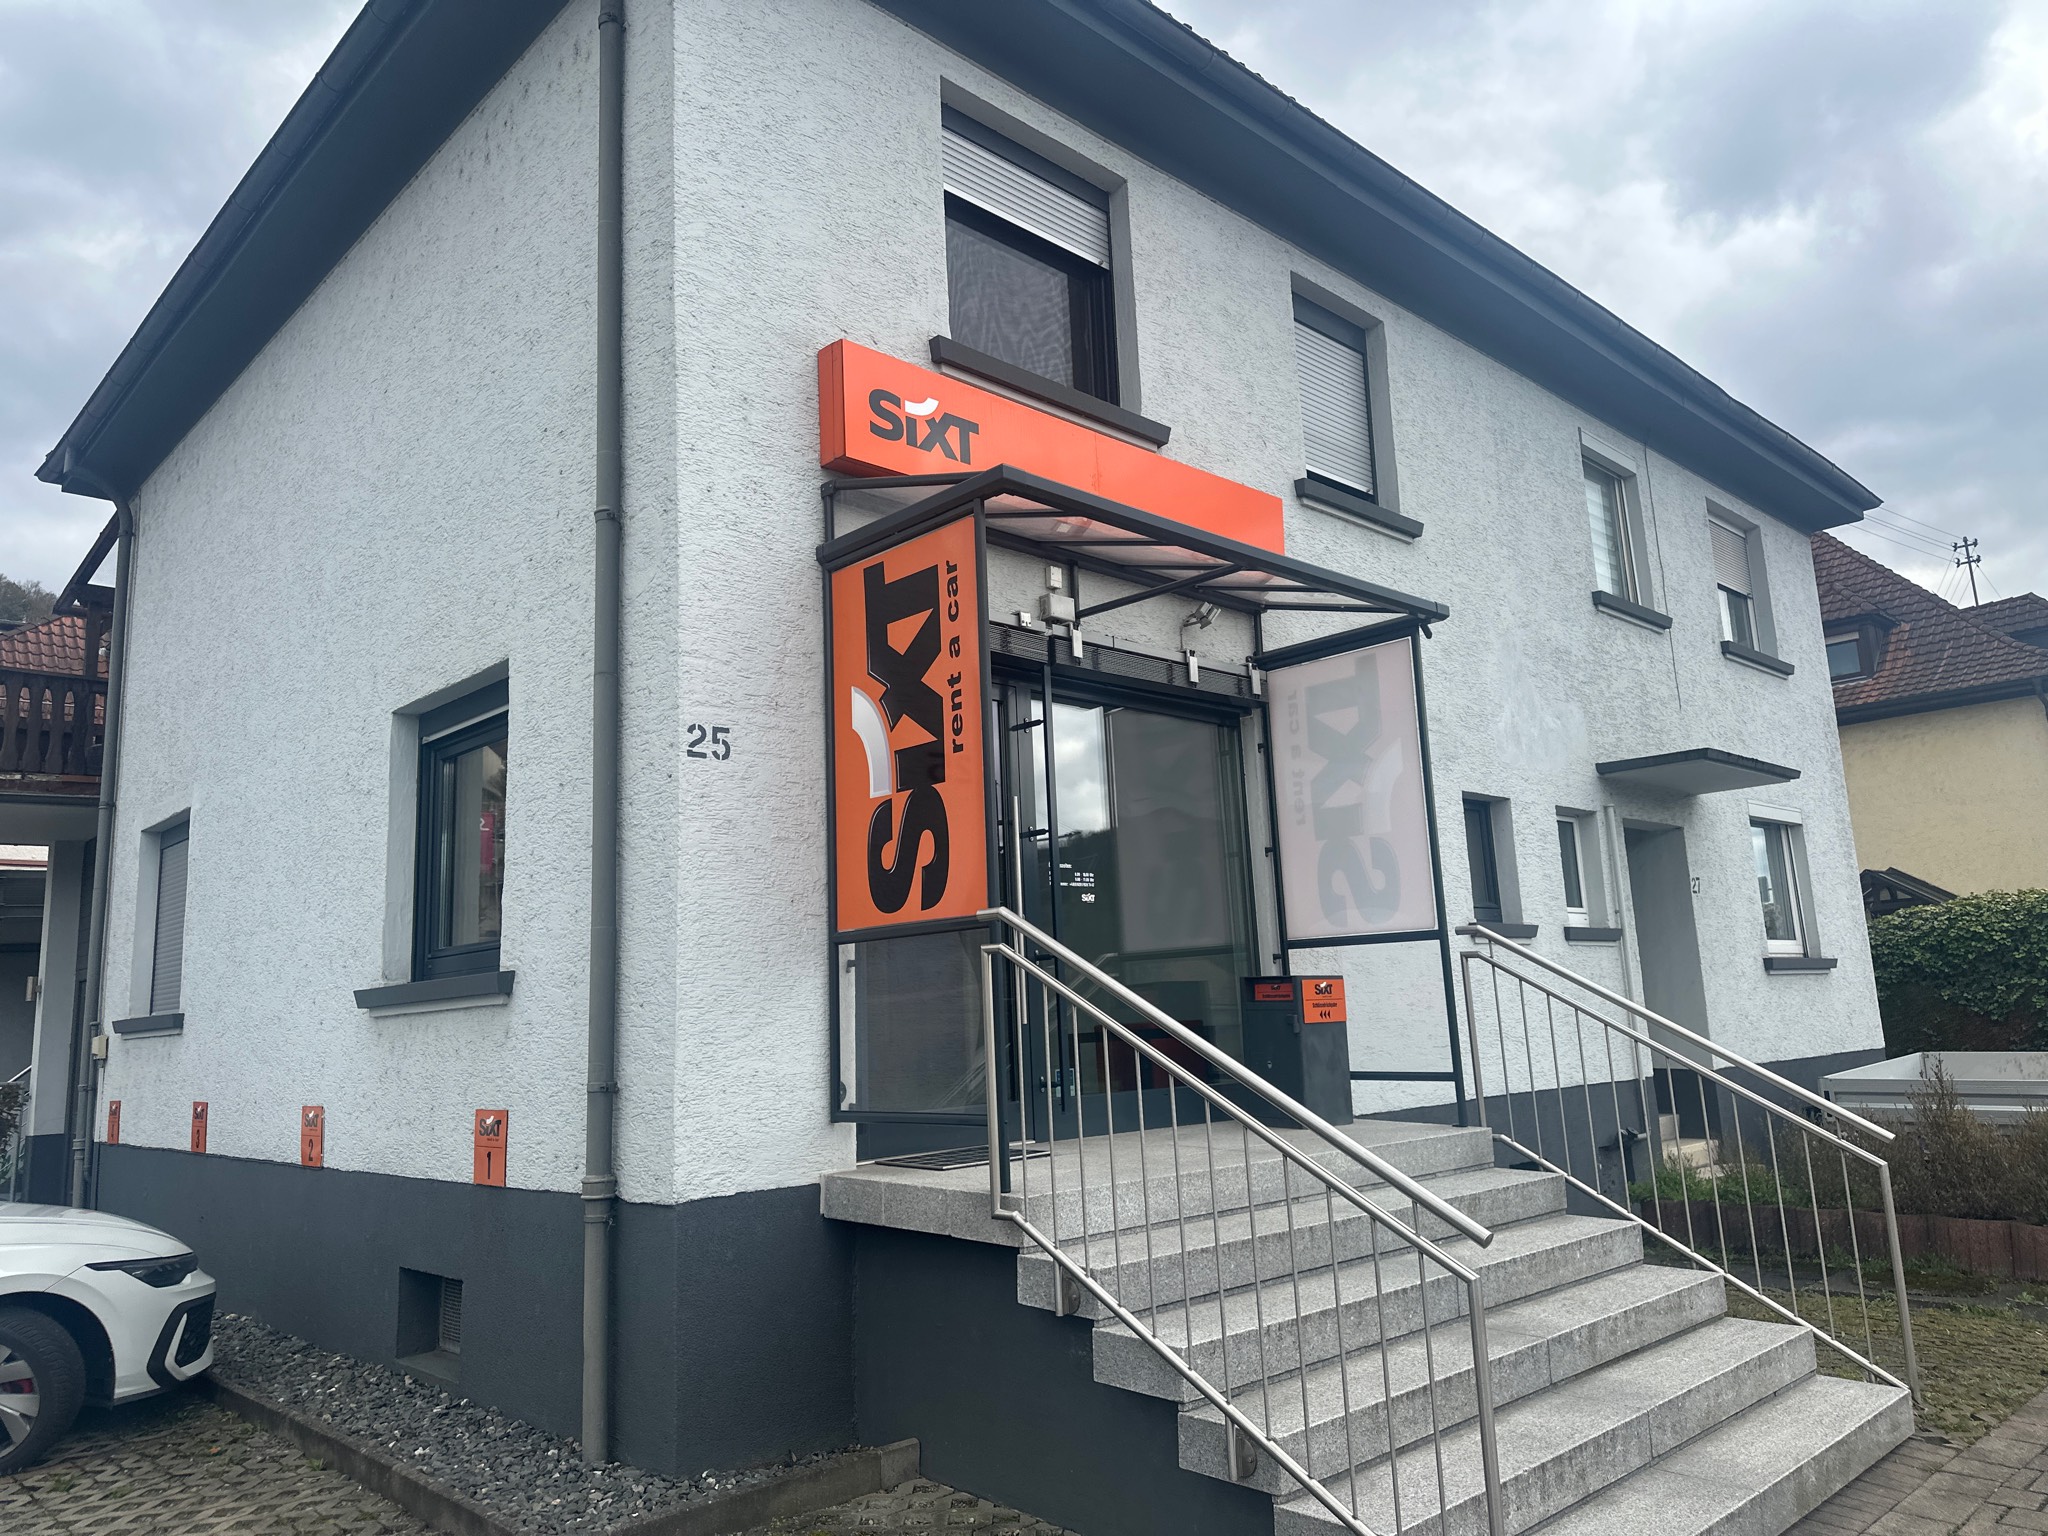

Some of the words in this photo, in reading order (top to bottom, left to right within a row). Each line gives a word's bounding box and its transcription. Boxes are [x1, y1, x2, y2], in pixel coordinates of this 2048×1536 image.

[868, 388, 979, 465] SIXT
[946, 560, 960, 623] car
[948, 634, 961, 659] a
[947, 671, 964, 754] rent
[687, 723, 731, 760] 25
[851, 561, 950, 914] SIXT
[1691, 877, 1700, 894] 27
[479, 1115, 502, 1137] SIXT
[308, 1138, 314, 1162] 2
[486, 1151, 492, 1180] 1
